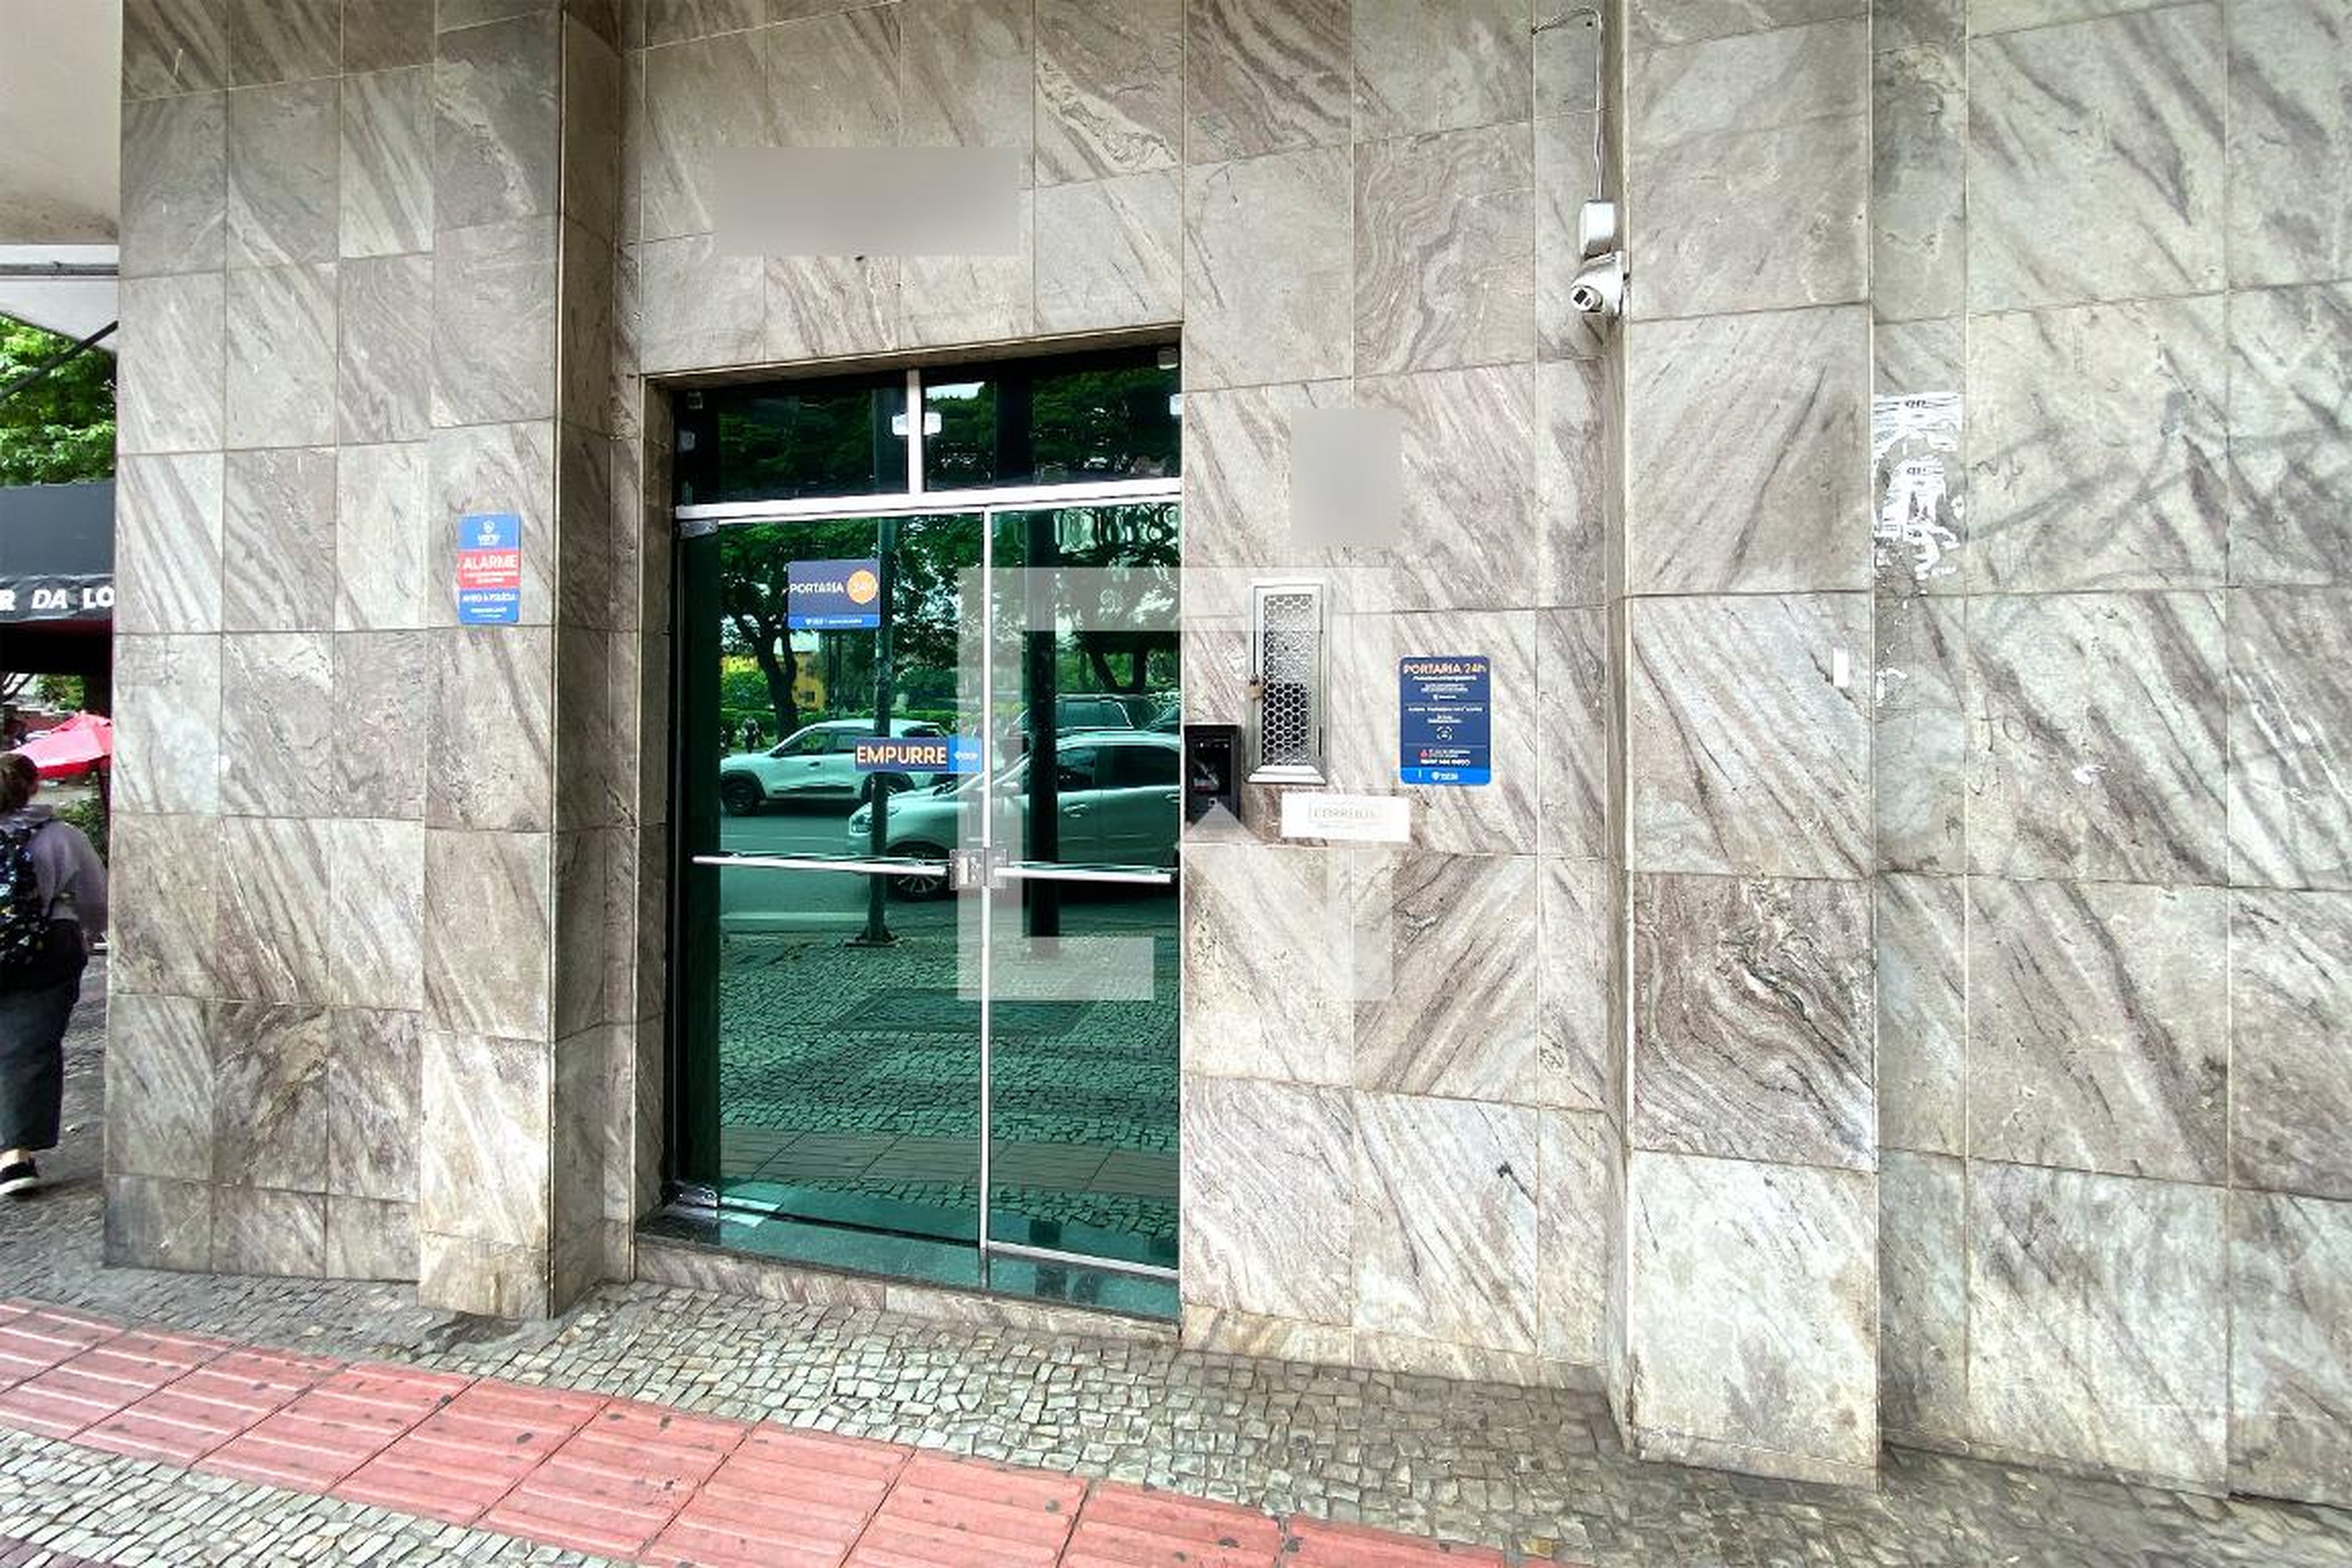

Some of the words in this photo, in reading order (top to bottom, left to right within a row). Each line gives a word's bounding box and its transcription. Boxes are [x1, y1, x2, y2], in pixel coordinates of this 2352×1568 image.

[462, 554, 518, 569] ALARME
[790, 582, 845, 594] PORTARIA
[31, 588, 68, 609] DA
[83, 586, 115, 609] LO
[1404, 663, 1461, 674] PORTARIA
[856, 745, 948, 765] EMPURRE
